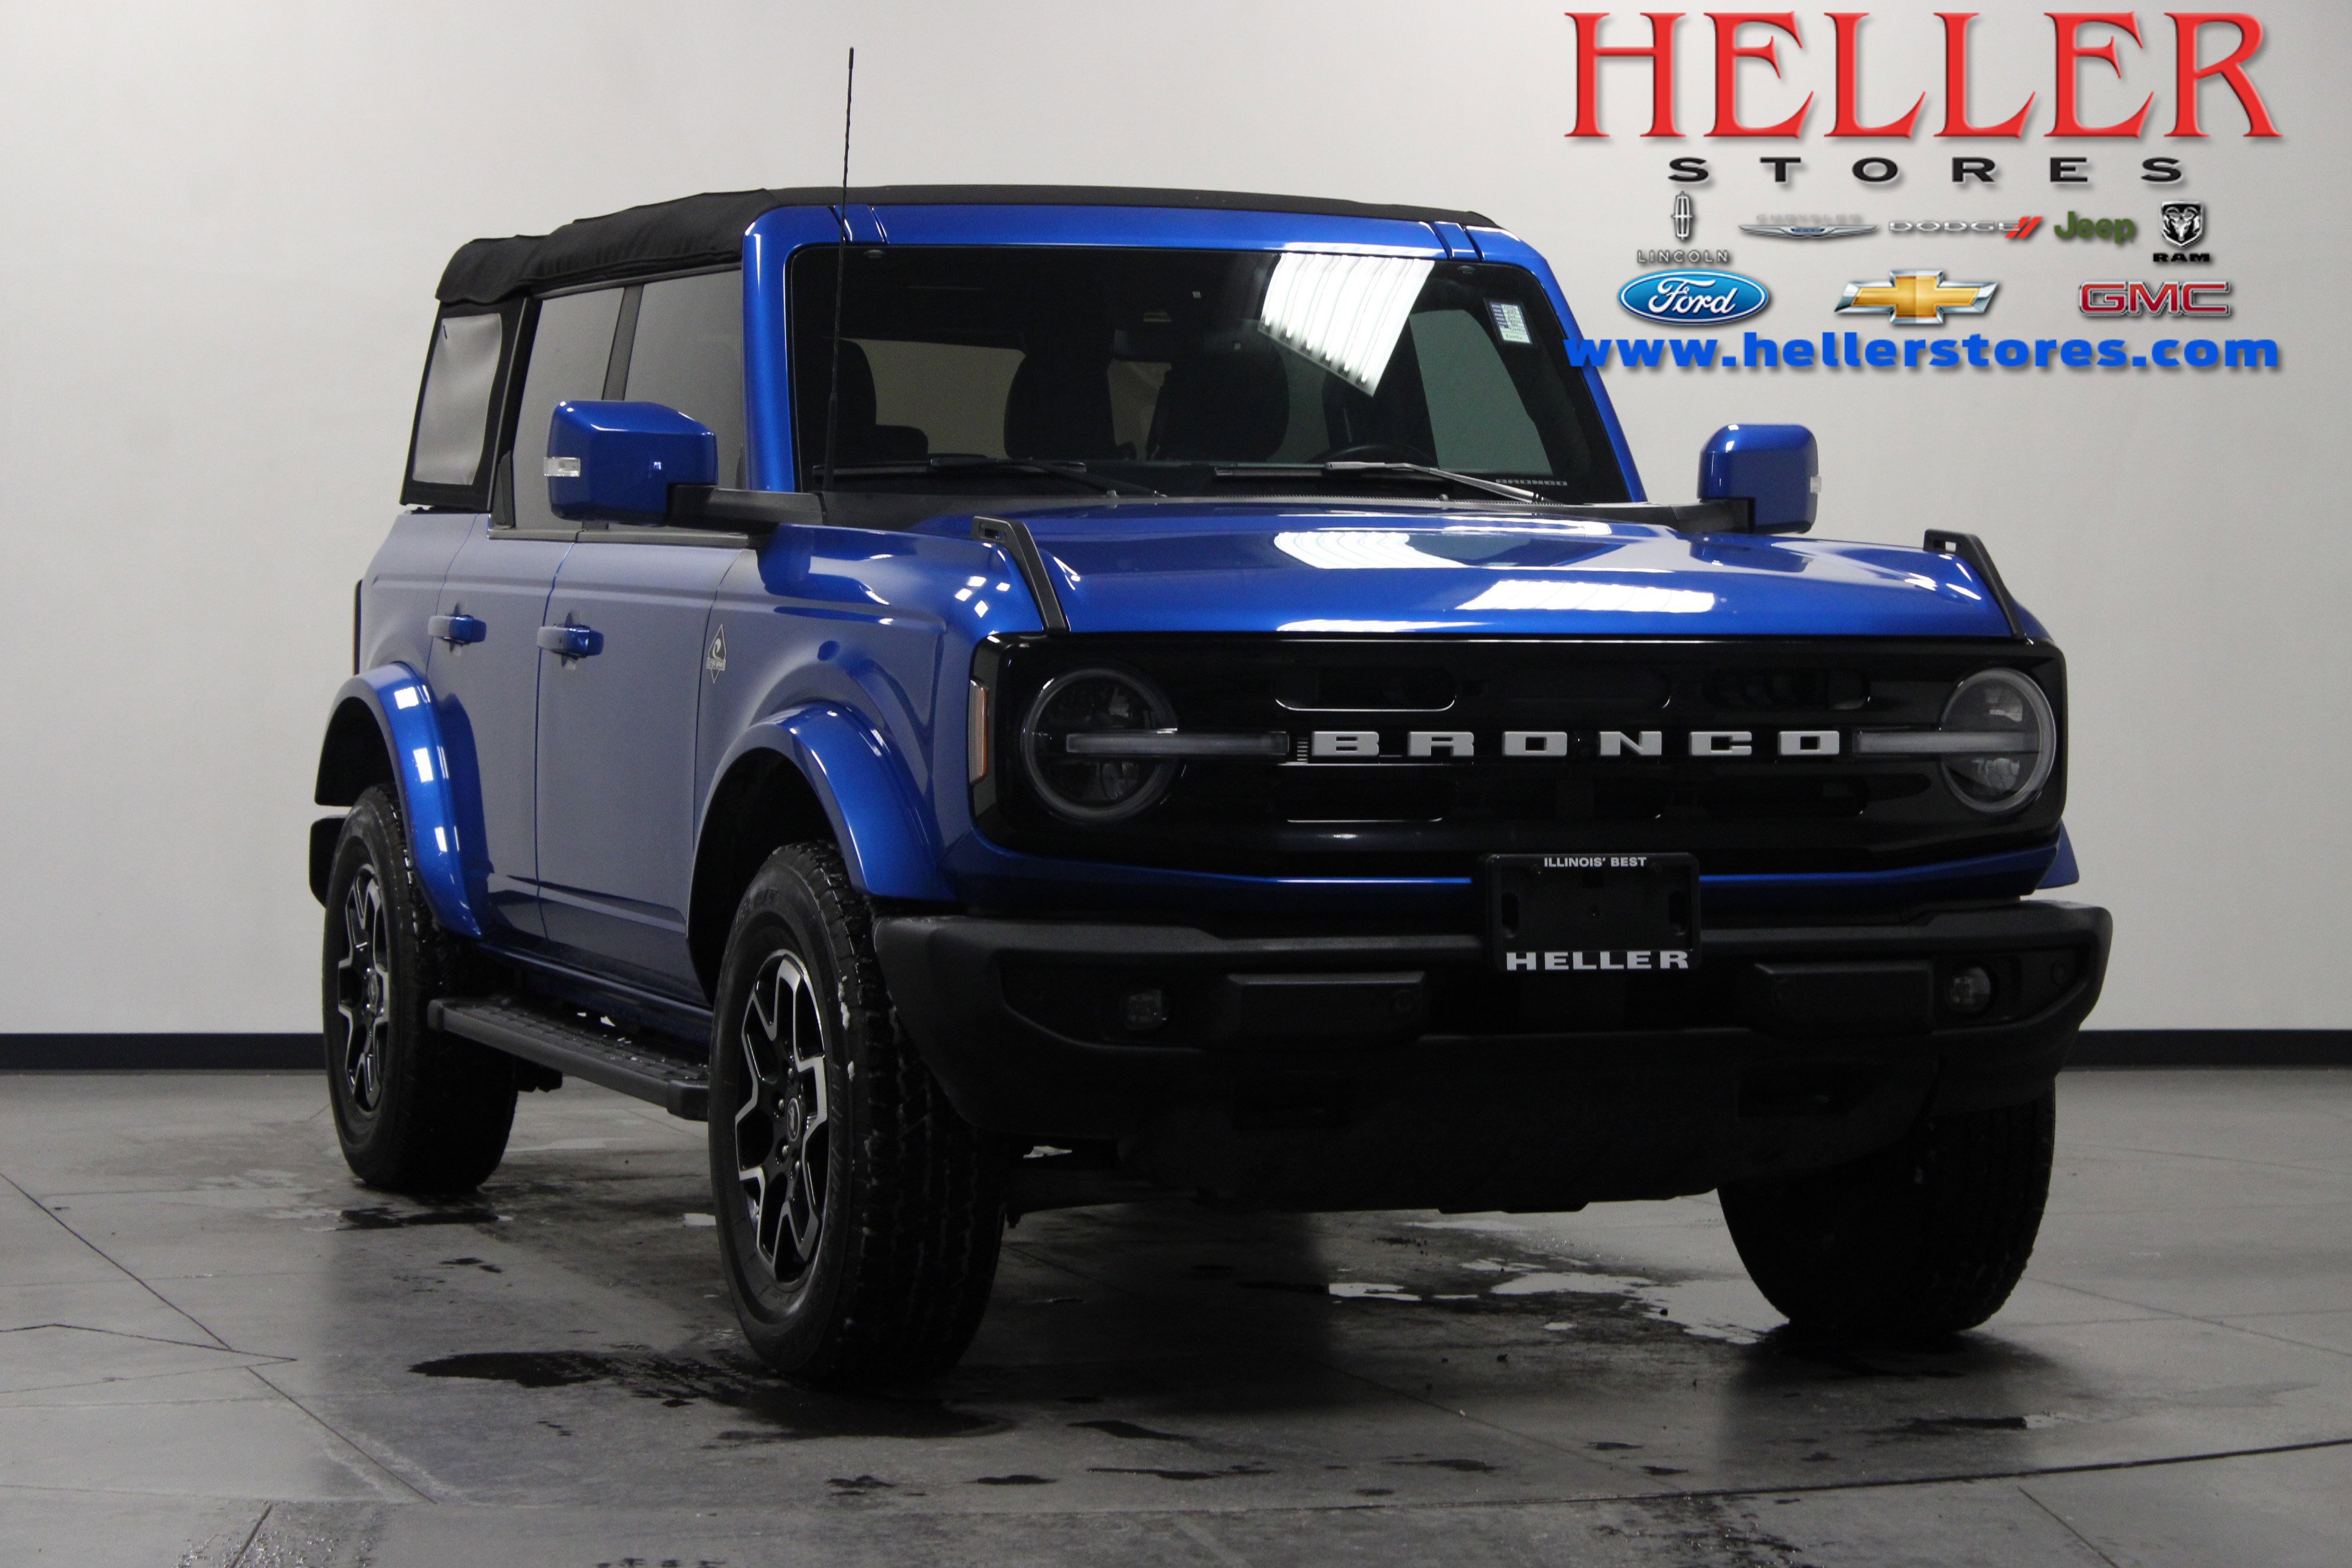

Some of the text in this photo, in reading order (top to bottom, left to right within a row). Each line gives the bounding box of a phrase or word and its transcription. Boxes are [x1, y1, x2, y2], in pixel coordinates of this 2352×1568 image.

[1312, 730, 1840, 756] BRONCO
[1544, 857, 1647, 868] ILLINOIS' BEST
[1506, 950, 1689, 971] HELLER
